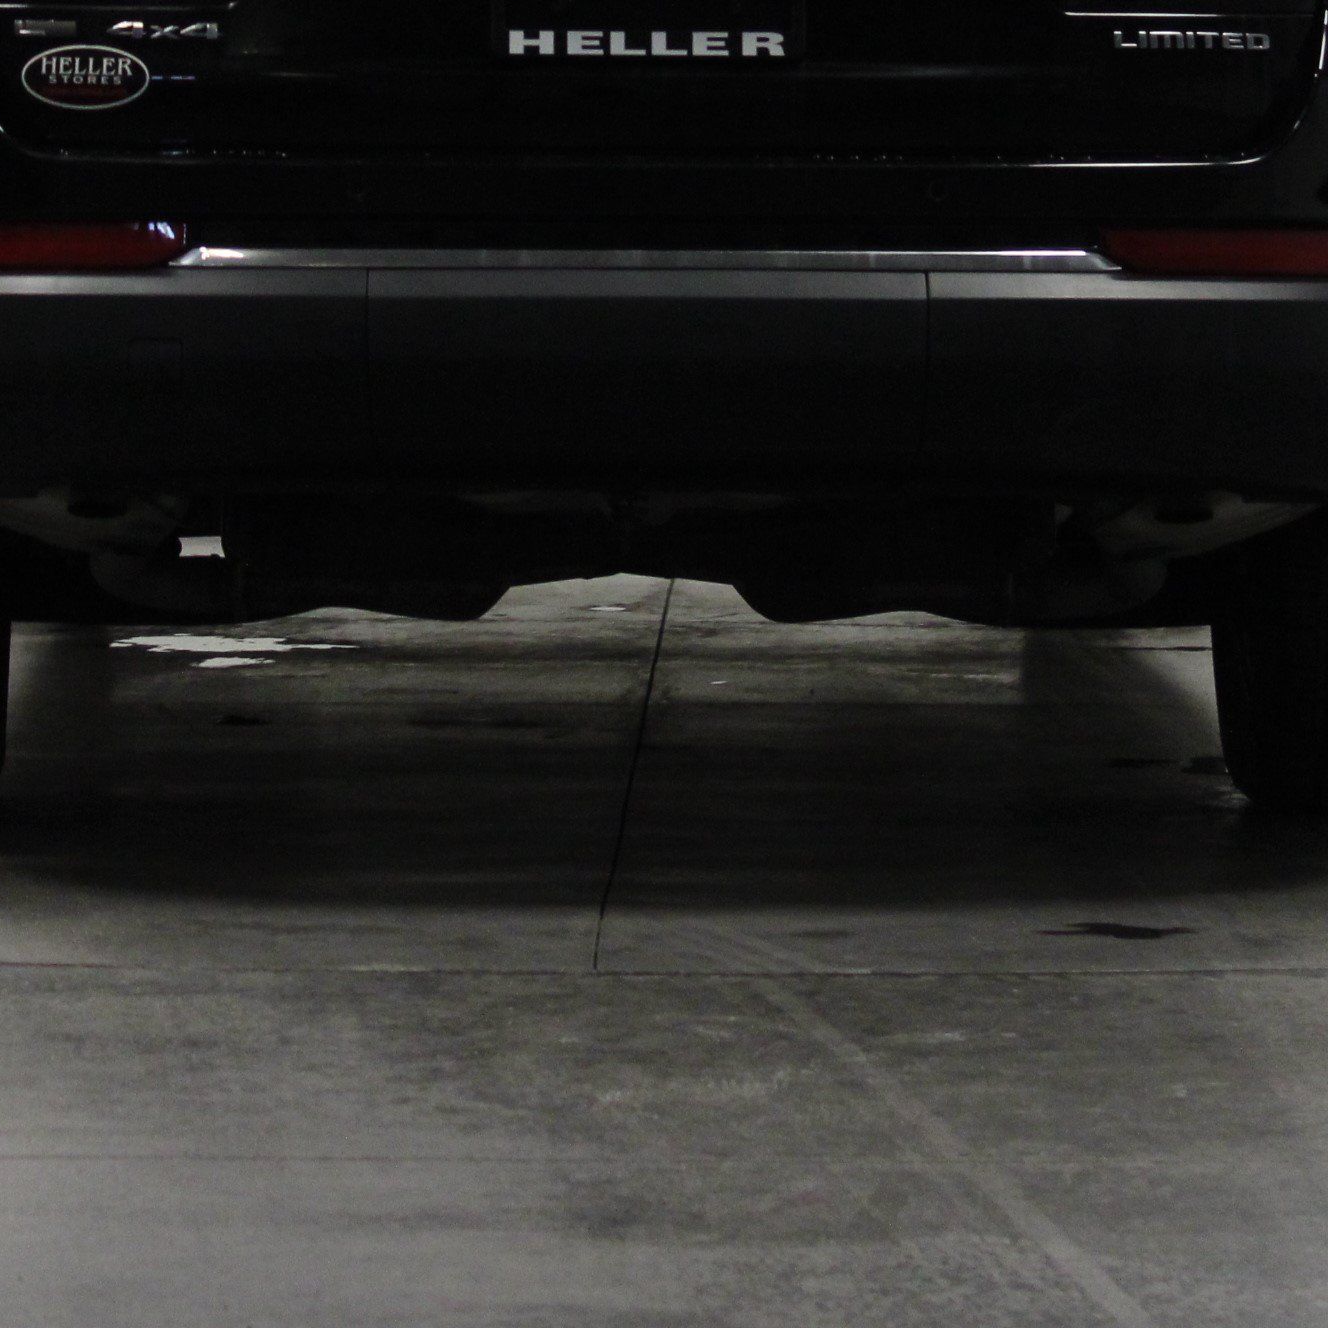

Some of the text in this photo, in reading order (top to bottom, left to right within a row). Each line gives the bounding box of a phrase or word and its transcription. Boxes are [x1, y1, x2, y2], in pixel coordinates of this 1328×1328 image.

[508, 29, 786, 57] HELLER
[1113, 30, 1270, 50] LIMITED
[41, 55, 133, 77] HELLER
[48, 75, 122, 85] STORES
